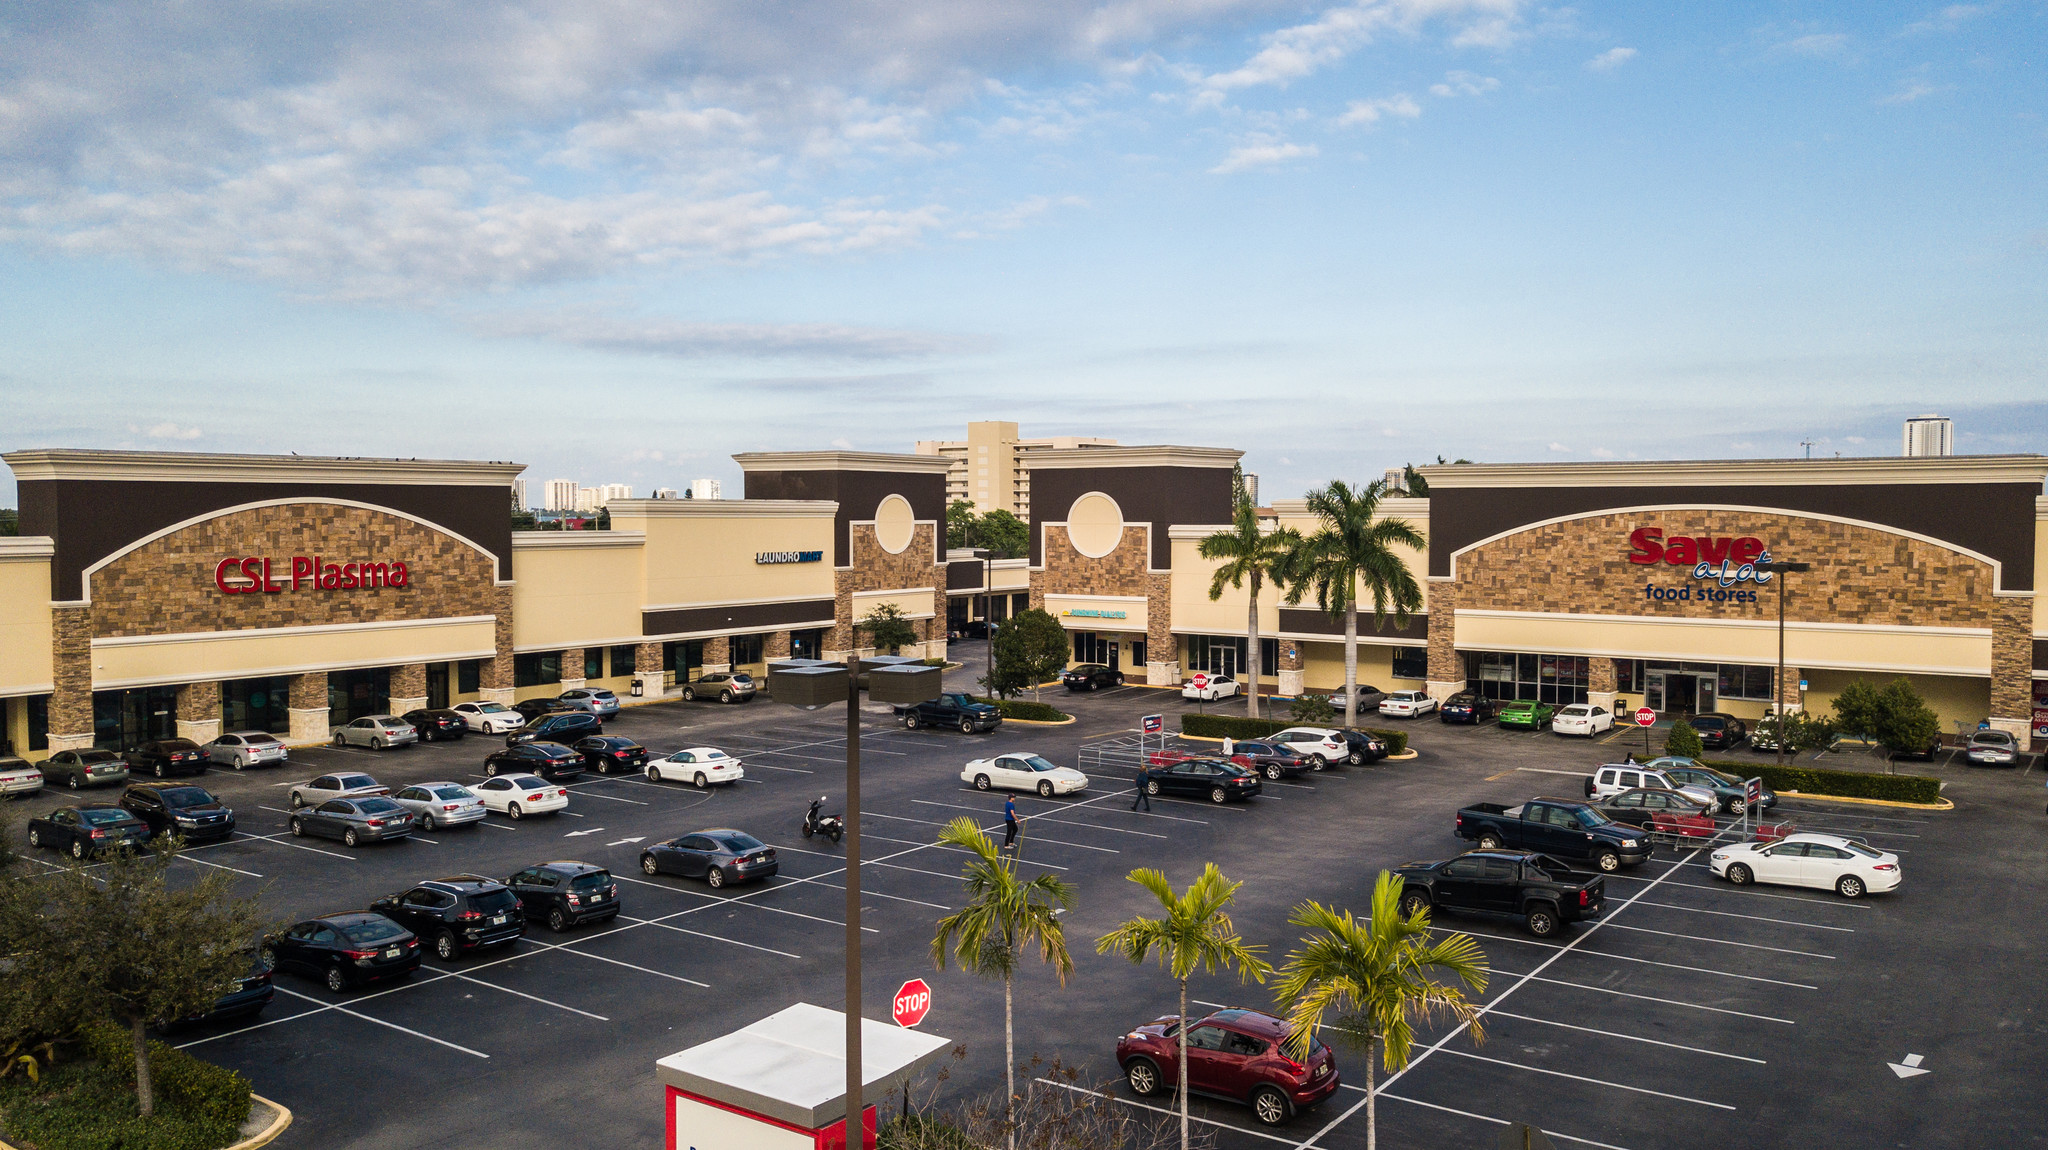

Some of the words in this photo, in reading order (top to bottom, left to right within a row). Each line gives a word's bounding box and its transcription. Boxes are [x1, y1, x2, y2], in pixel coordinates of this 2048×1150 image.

[1630, 527, 1764, 566] Save
[215, 557, 281, 594] CSL
[291, 556, 408, 591] Plasma
[1645, 584, 1690, 600] food
[1697, 587, 1757, 602] stores
[1193, 677, 1207, 685] STOP
[1636, 713, 1654, 721] STOP
[896, 992, 928, 1015] STOP
